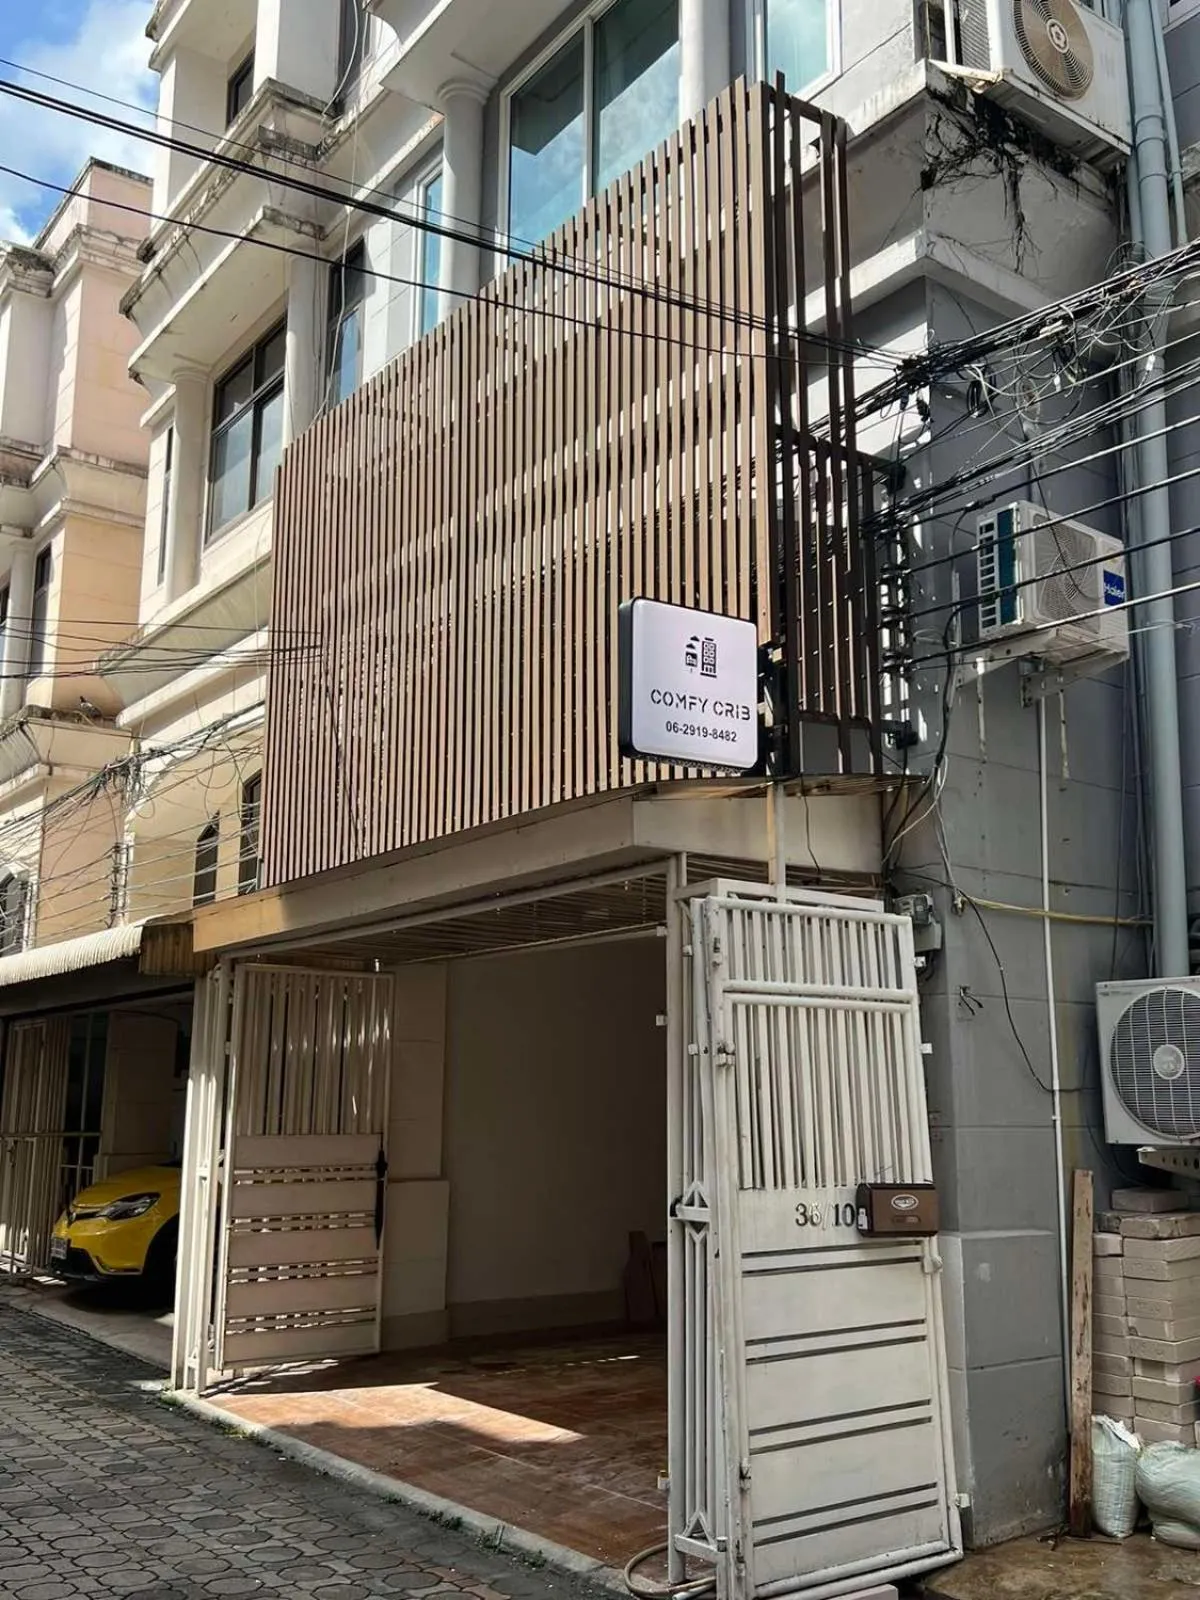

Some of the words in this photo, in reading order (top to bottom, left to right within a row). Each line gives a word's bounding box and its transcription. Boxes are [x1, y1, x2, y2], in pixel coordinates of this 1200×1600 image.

[1104, 582, 1125, 599] Haier
[650, 688, 708, 714] COMFY
[713, 700, 751, 721] CRIB
[665, 720, 737, 743] 06-2919-8482
